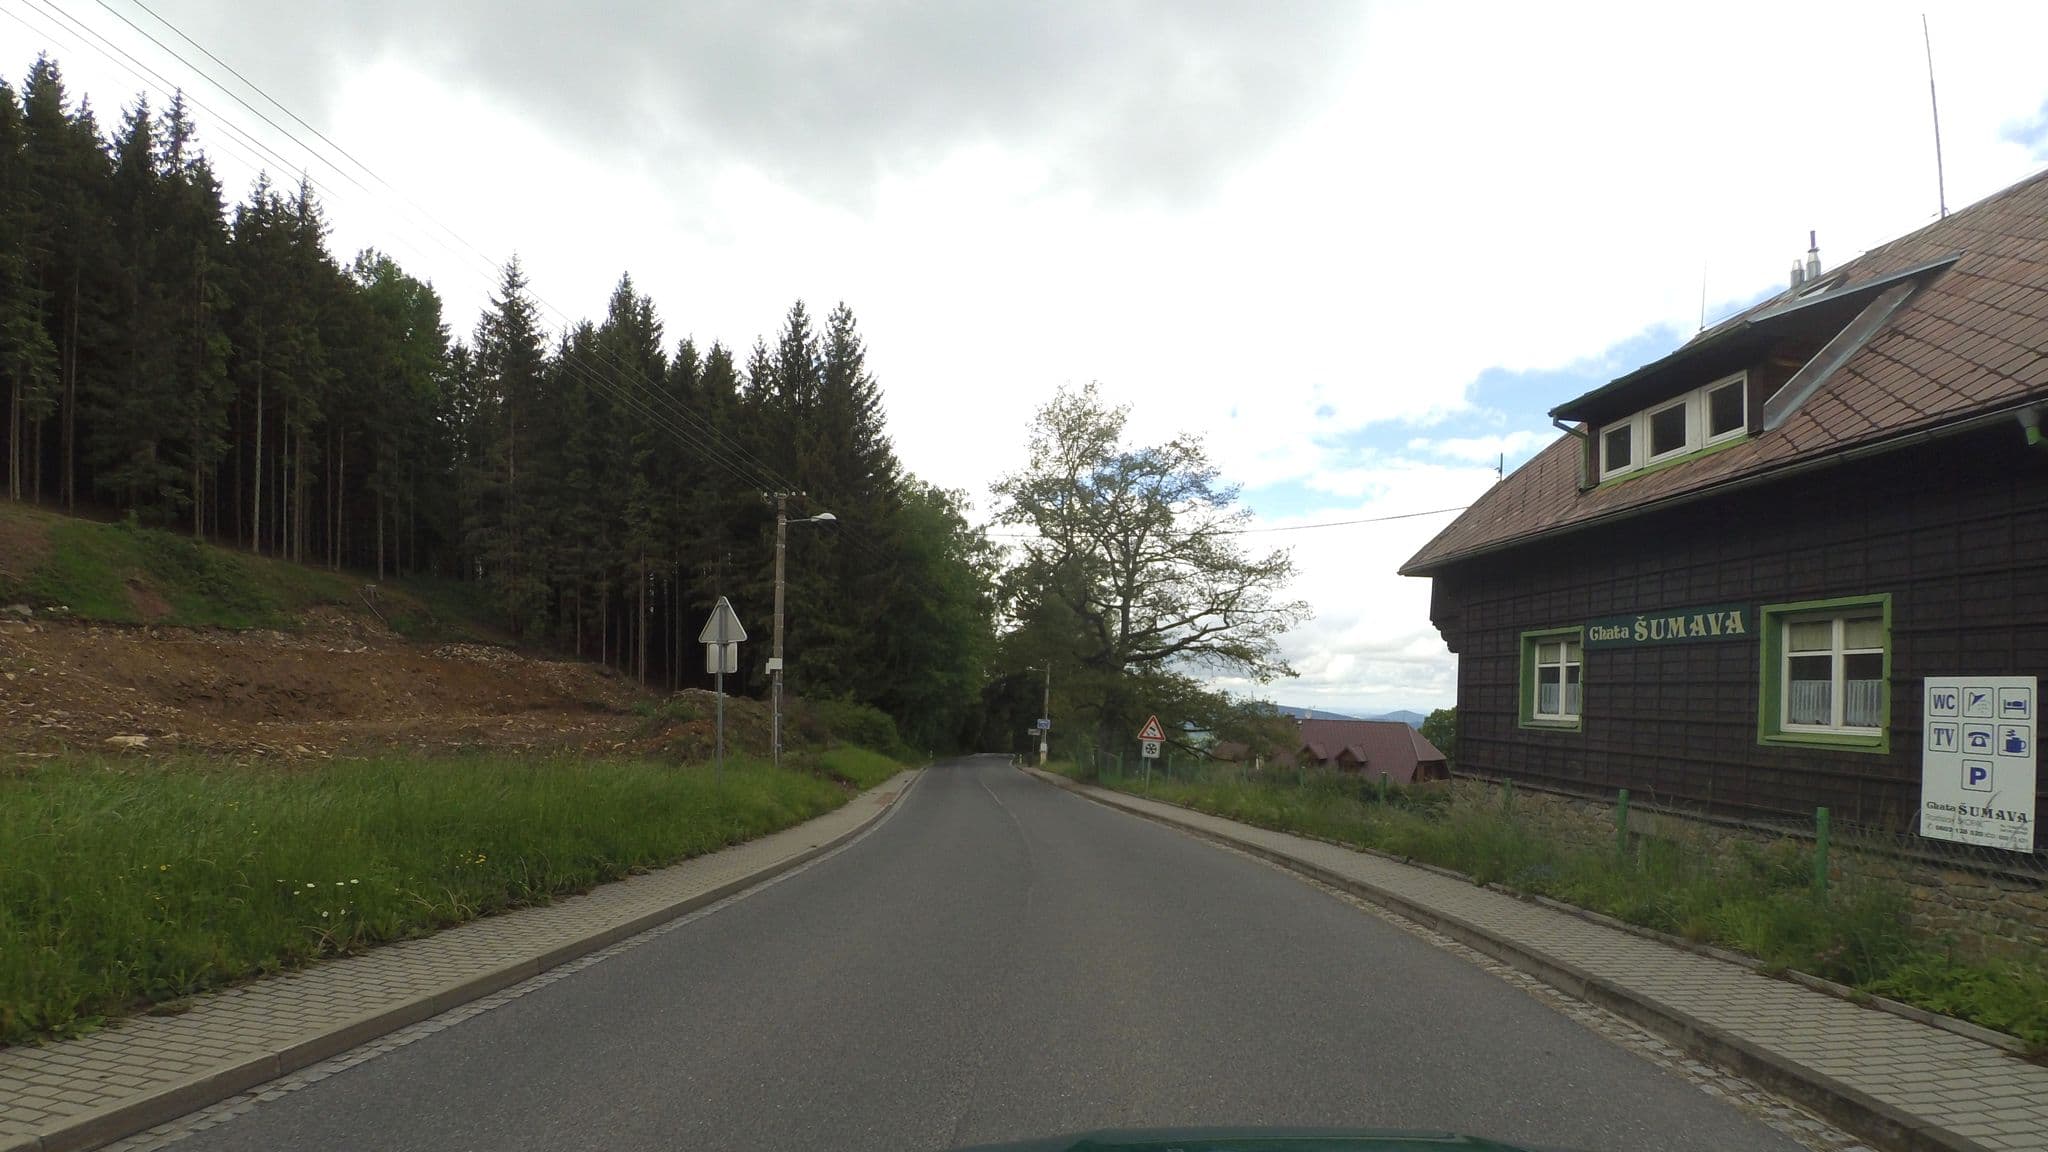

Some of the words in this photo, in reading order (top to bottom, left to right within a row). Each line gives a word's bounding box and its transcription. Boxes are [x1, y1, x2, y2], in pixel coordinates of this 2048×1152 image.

[1634, 611, 1746, 642] ŠUMAVA
[1933, 694, 1955, 710] WC
[1933, 727, 1955, 747] TV
[1969, 766, 1987, 786] P
[1958, 802, 2028, 824] ŠUMAVA
